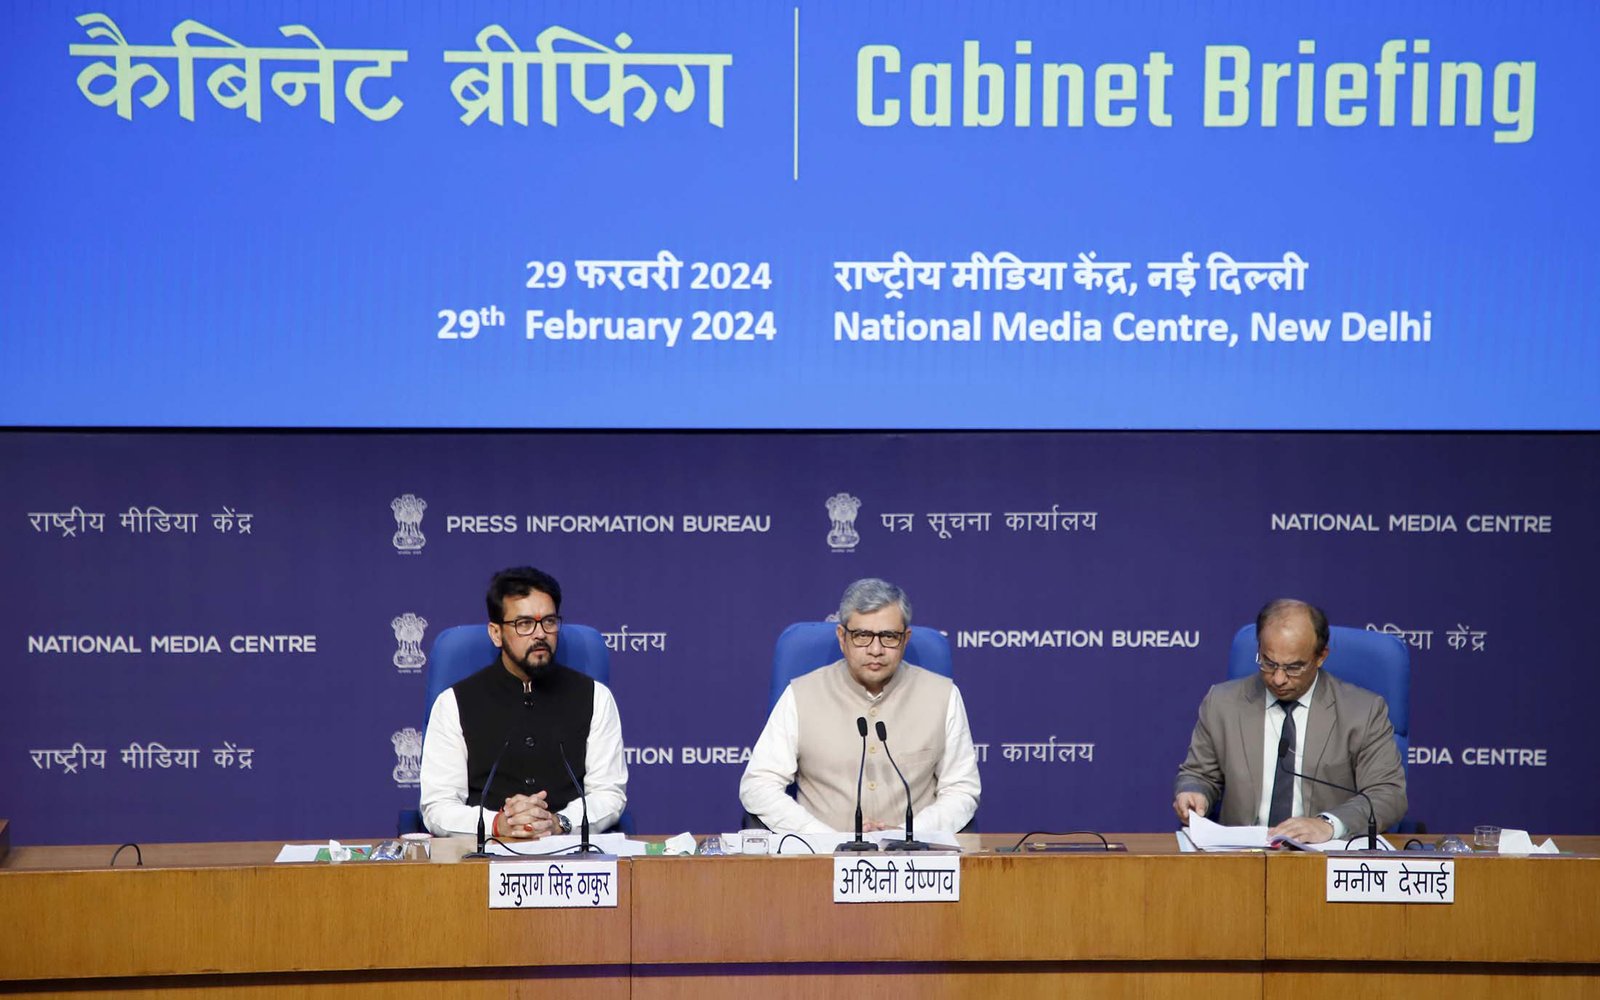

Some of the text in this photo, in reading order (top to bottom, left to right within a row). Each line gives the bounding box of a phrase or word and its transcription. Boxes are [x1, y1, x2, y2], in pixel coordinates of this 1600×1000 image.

[70, 13, 732, 128] कैबिनेट ब्रीफिंग
[857, 39, 1535, 143] Cabinet Briefing
[526, 250, 772, 291] 29 फरवरी 2024
[834, 251, 1308, 299] राष्ट्रीय मीडिया केंद्र, नई दिल्ली
[437, 305, 777, 347] 29th February 2024
[834, 311, 1432, 348] National Media Centre, New Delhi
[28, 506, 254, 537] राष्ट्रीय मीडिया केंद्र
[446, 515, 771, 533] PRESS INFORMATION BUREAU
[881, 504, 1098, 538] पत्र सूचना कार्यालय
[1271, 513, 1552, 533] NATIONAL MEDIA CENTRE
[28, 635, 317, 654] NATIONAL MEDIA CENTRE
[601, 625, 667, 652] र्यालय
[957, 630, 1200, 648] INFORMATION BUREAU
[1446, 623, 1487, 651] केंद्र
[30, 742, 255, 774] राष्ट्रीय मीडिया केंद्र
[682, 747, 752, 764] BUREA
[1001, 735, 1095, 762] कार्यालय
[1408, 747, 1547, 766] EDIA CENTRE
[499, 864, 610, 906] अनुराग सिंह ठाकुर
[840, 859, 955, 894] अश्विनी वैष्णव
[1333, 862, 1450, 900] मनीष देसाई
